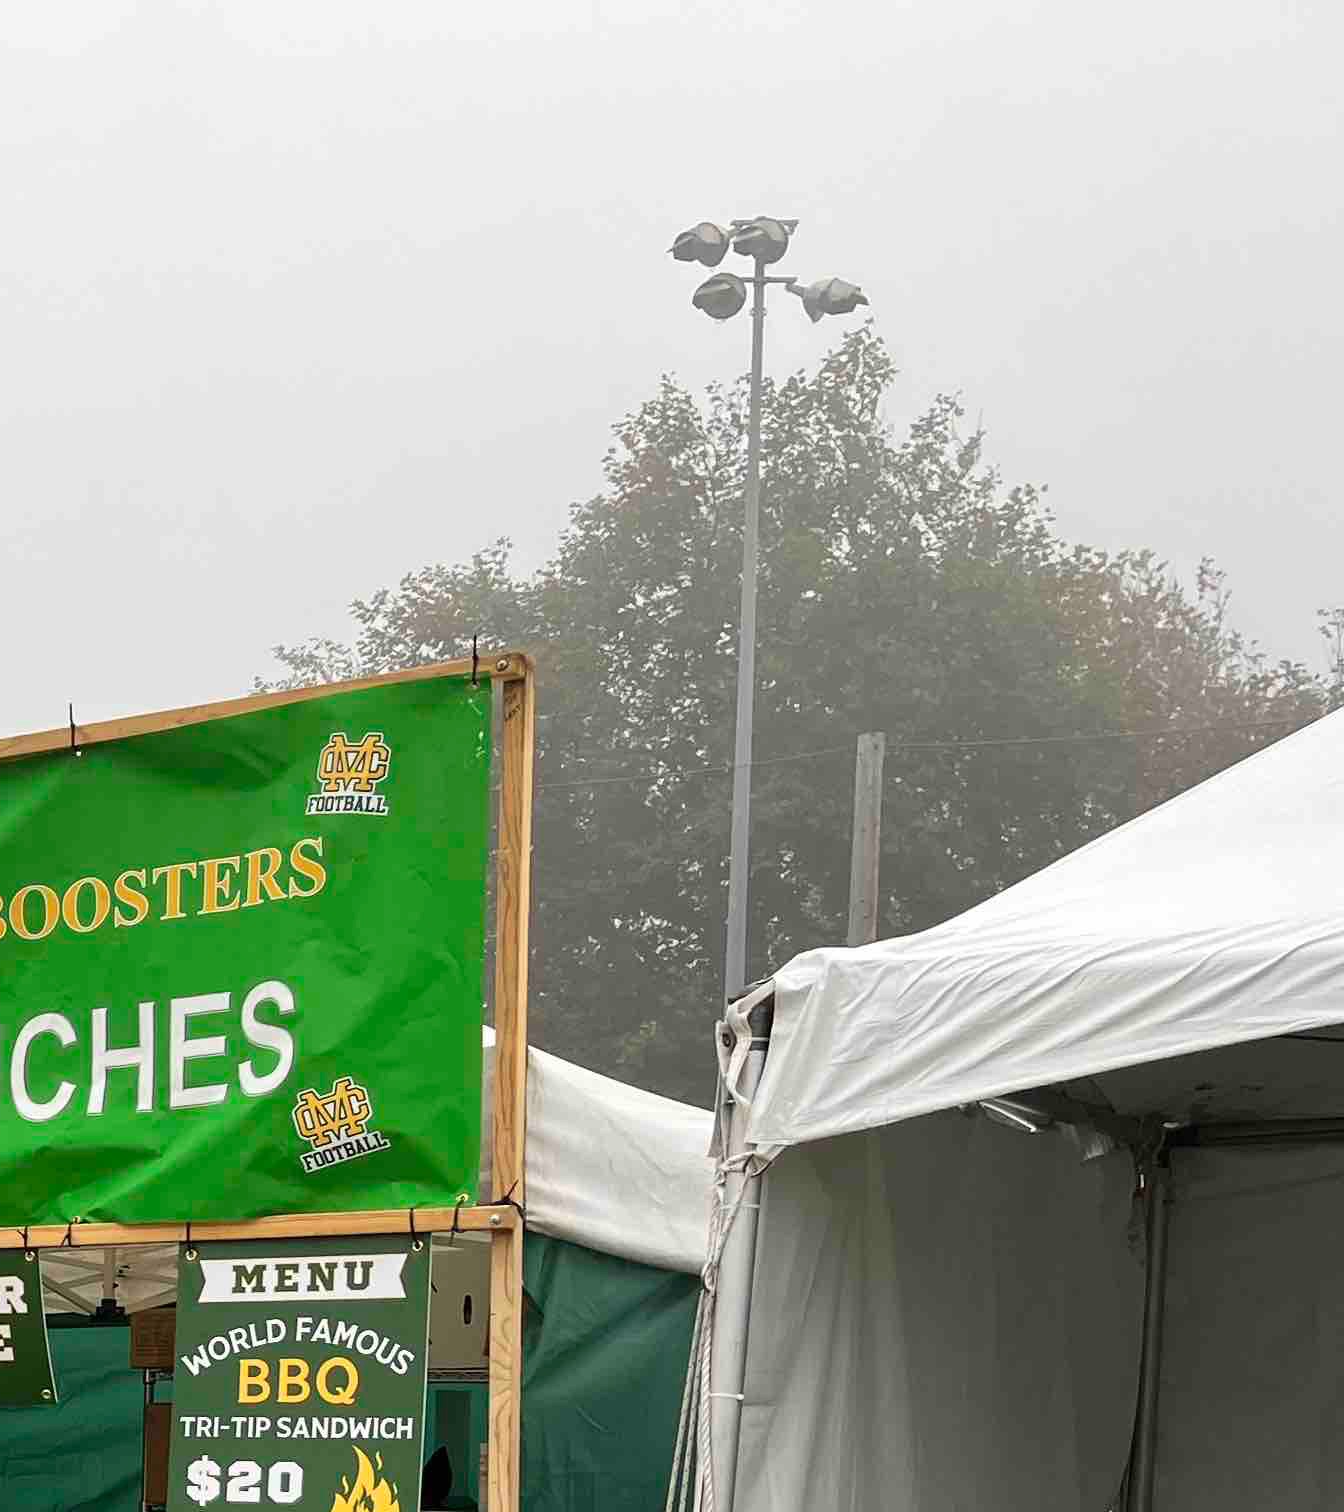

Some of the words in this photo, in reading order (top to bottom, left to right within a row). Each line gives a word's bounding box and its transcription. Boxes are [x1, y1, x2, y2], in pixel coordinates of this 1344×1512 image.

[306, 795, 386, 813] FOOTBALL
[302, 1133, 389, 1170] FOOTBALL
[231, 1260, 374, 1294] MENU
[181, 1318, 287, 1376] WORLD
[295, 1317, 415, 1375] FAMOUS
[238, 1356, 360, 1405] BBQ
[180, 1416, 271, 1438] TRI-TIP
[276, 1416, 413, 1439] SANDWICH
[186, 1455, 304, 1507] $20
